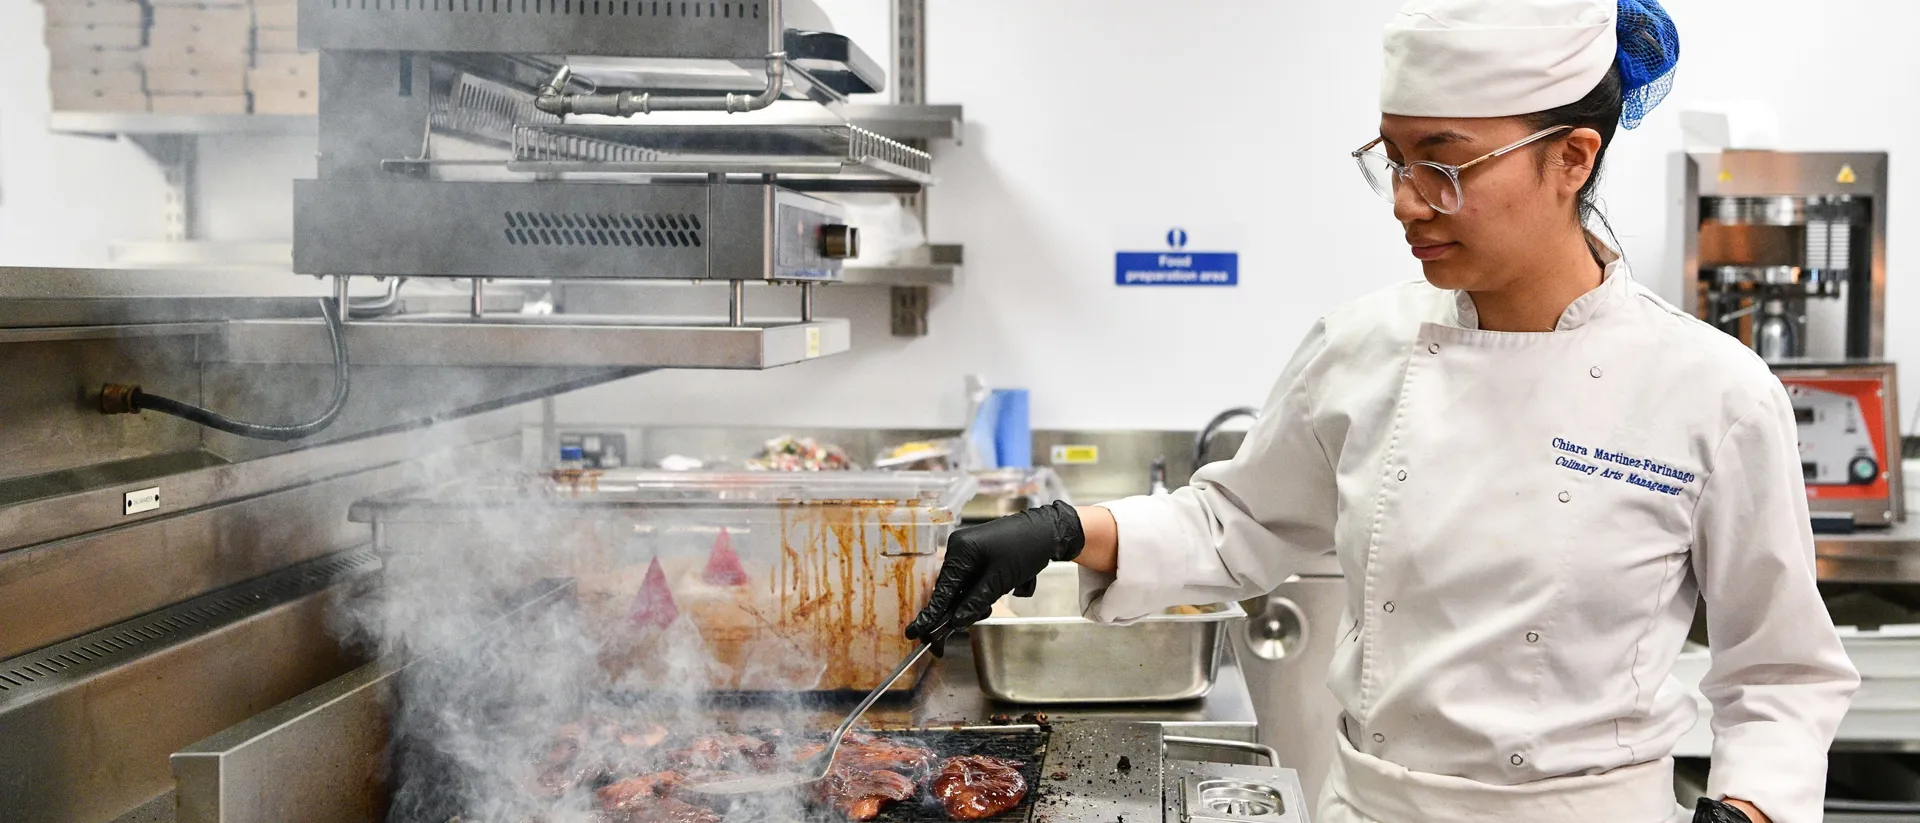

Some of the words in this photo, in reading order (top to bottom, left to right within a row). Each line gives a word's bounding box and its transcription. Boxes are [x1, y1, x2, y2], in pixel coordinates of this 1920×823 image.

[1158, 255, 1193, 267] Food
[1125, 270, 1198, 282] preparation
[1199, 271, 1229, 281] area
[1552, 437, 1587, 456] Chiara
[1593, 448, 1695, 484] Martinez-Farinango
[1555, 456, 1598, 475] Culinary
[1600, 467, 1624, 480] Arts
[1626, 472, 1684, 496] Management
